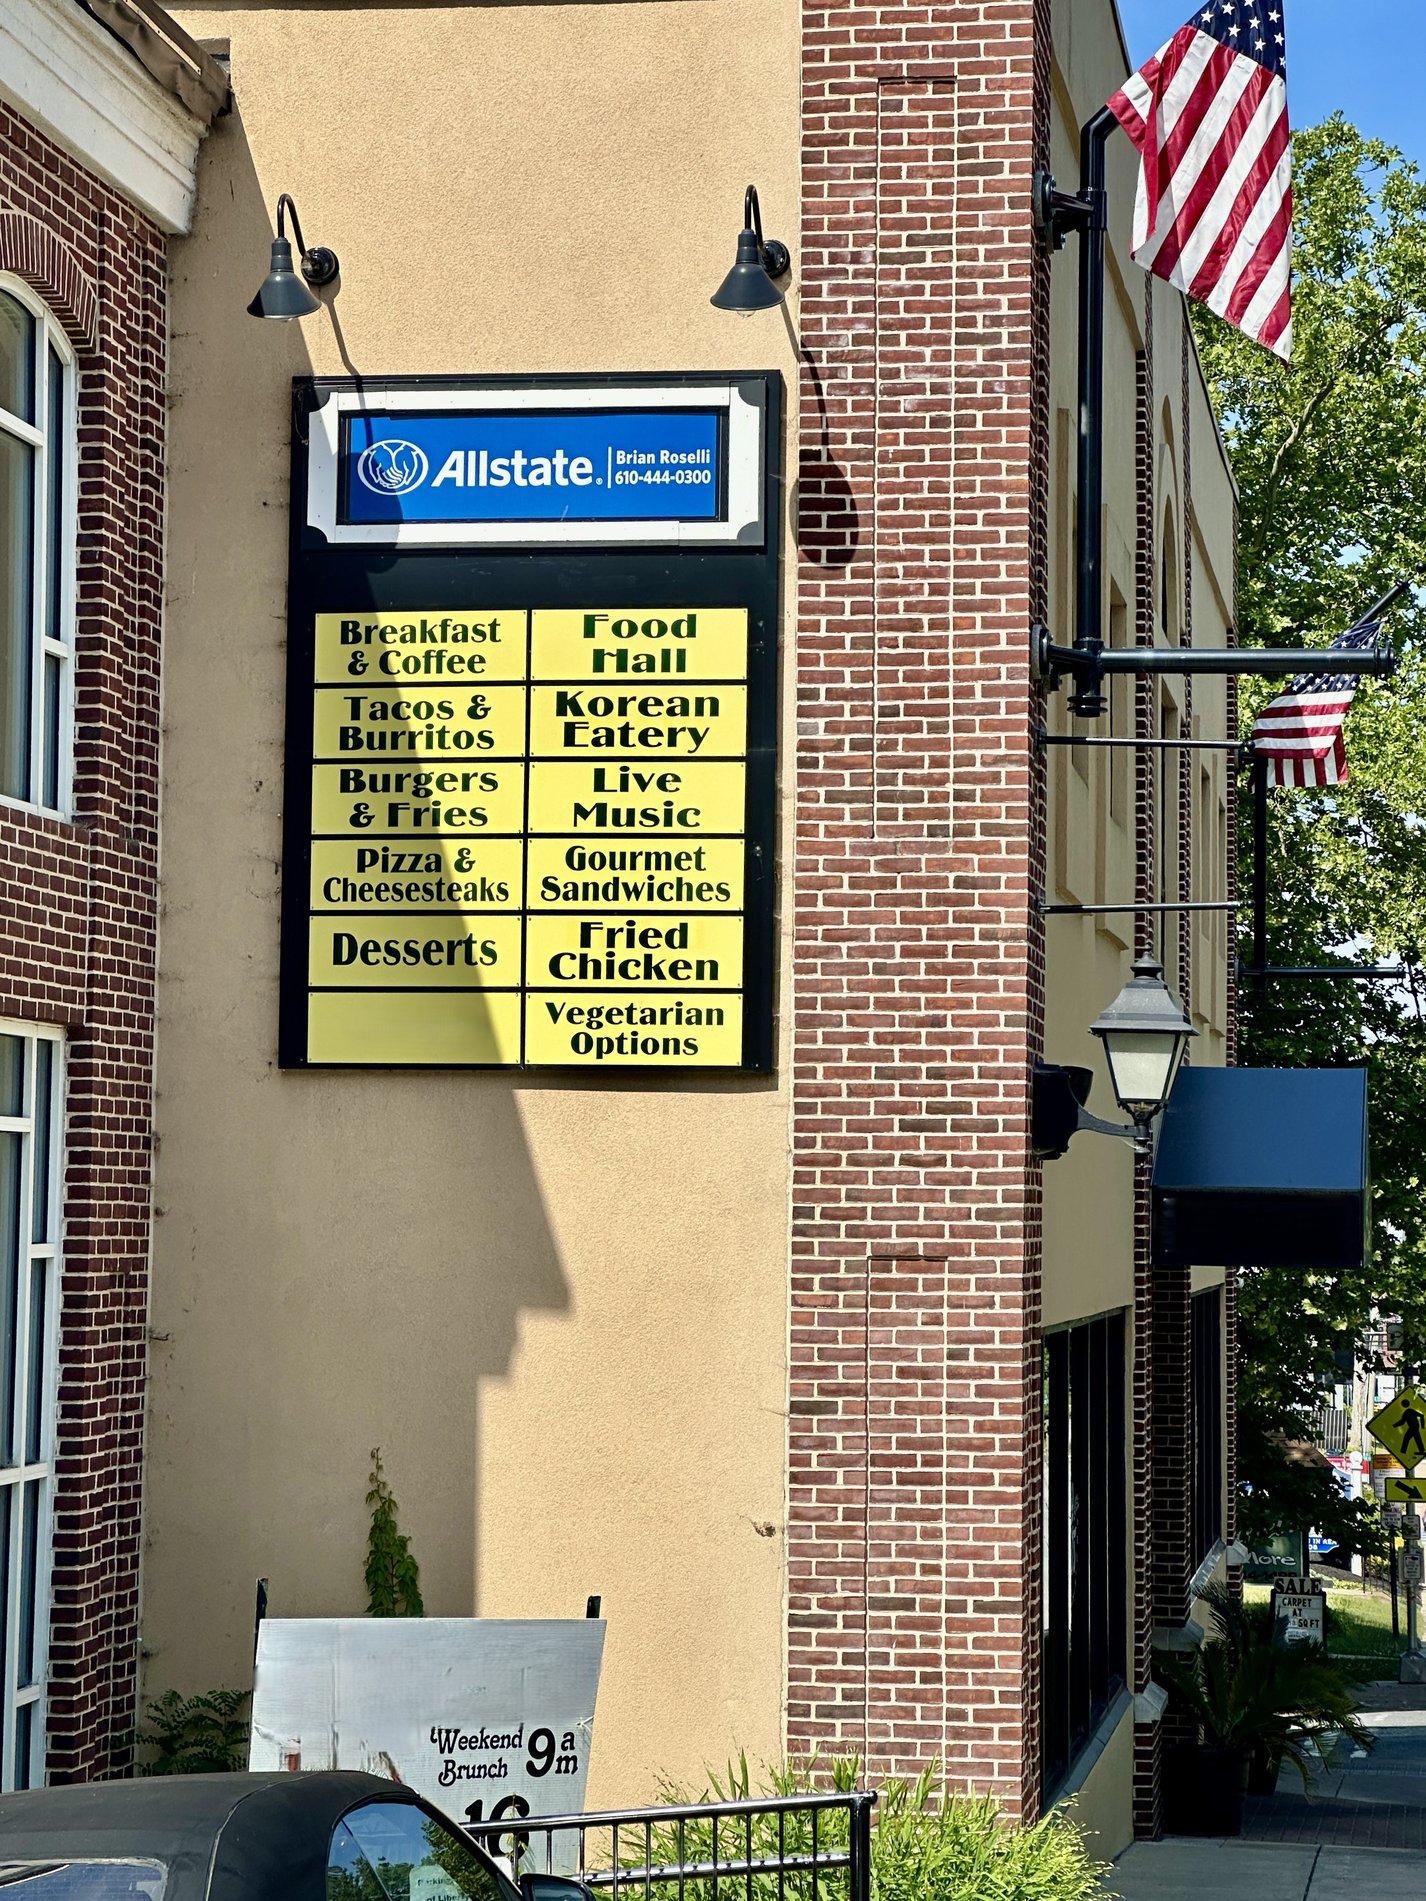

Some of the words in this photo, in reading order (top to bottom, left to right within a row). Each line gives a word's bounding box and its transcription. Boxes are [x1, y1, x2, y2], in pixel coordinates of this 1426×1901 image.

[431, 449, 593, 487] Allstate
[616, 449, 655, 465] Brian
[660, 448, 711, 465] Roselli
[614, 469, 711, 485] 610-444-0300
[340, 618, 502, 645] Breakfast
[583, 613, 697, 639] Food
[347, 650, 370, 676] &
[379, 649, 487, 675] Coffee
[592, 648, 687, 673] Hall
[344, 695, 455, 721] Tacos
[467, 694, 492, 720] &
[555, 690, 720, 717] Korean
[339, 723, 495, 751] Burritos
[563, 721, 710, 754] Eatery
[339, 768, 499, 799] Burgers
[593, 765, 682, 793] Live
[348, 802, 376, 828] &
[387, 800, 489, 828] Fries
[573, 800, 701, 828] Music
[356, 846, 442, 873] Pizza
[454, 847, 476, 873] &
[565, 845, 707, 871] Gourmet
[323, 877, 510, 903] Cheesesteaks
[540, 874, 731, 902] Sandwiches
[579, 919, 689, 949] Fried
[332, 932, 498, 966] Desserts
[548, 950, 719, 981] Chicken
[545, 1001, 725, 1030] Vegetarian
[570, 1031, 699, 1060] Options
[1274, 1577, 1322, 1595] SALE
[1282, 1597, 1312, 1607] CARPET
[1292, 1608, 1303, 1617] AT
[430, 1722, 525, 1755] Weekend
[526, 1727, 556, 1778] 9
[438, 1757, 509, 1787] Brunch
[417, 1878, 453, 1888] Prking
